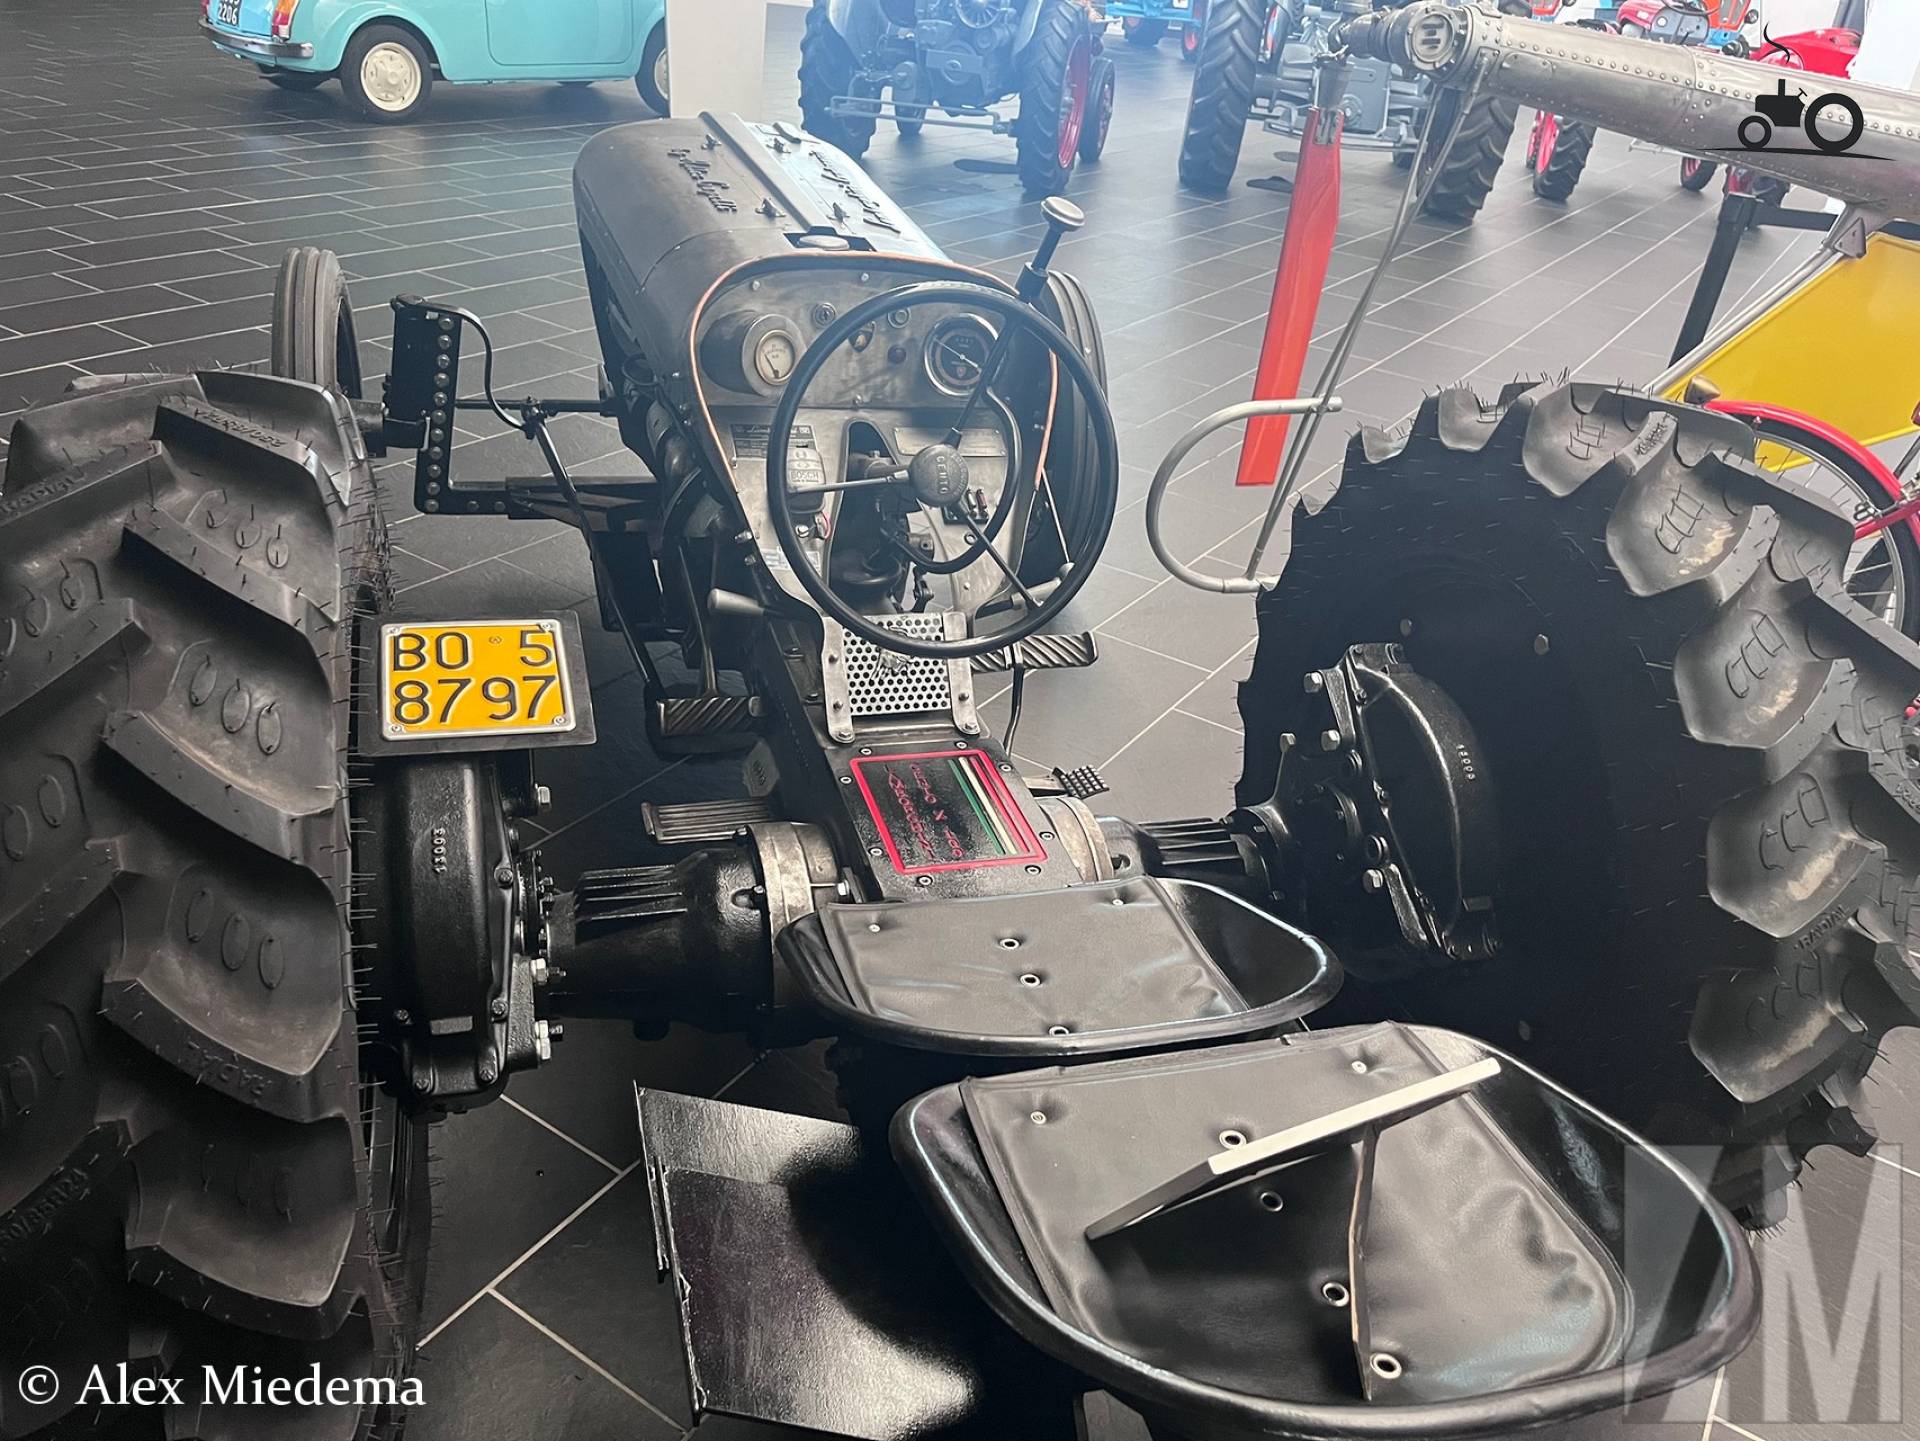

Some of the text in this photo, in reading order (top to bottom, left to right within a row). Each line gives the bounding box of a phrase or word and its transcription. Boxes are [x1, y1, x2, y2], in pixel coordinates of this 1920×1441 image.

[217, 3, 239, 25] 2206
[393, 629, 554, 671] BO 5
[394, 675, 556, 725] 8797
[1798, 904, 1850, 949] RADIAL
